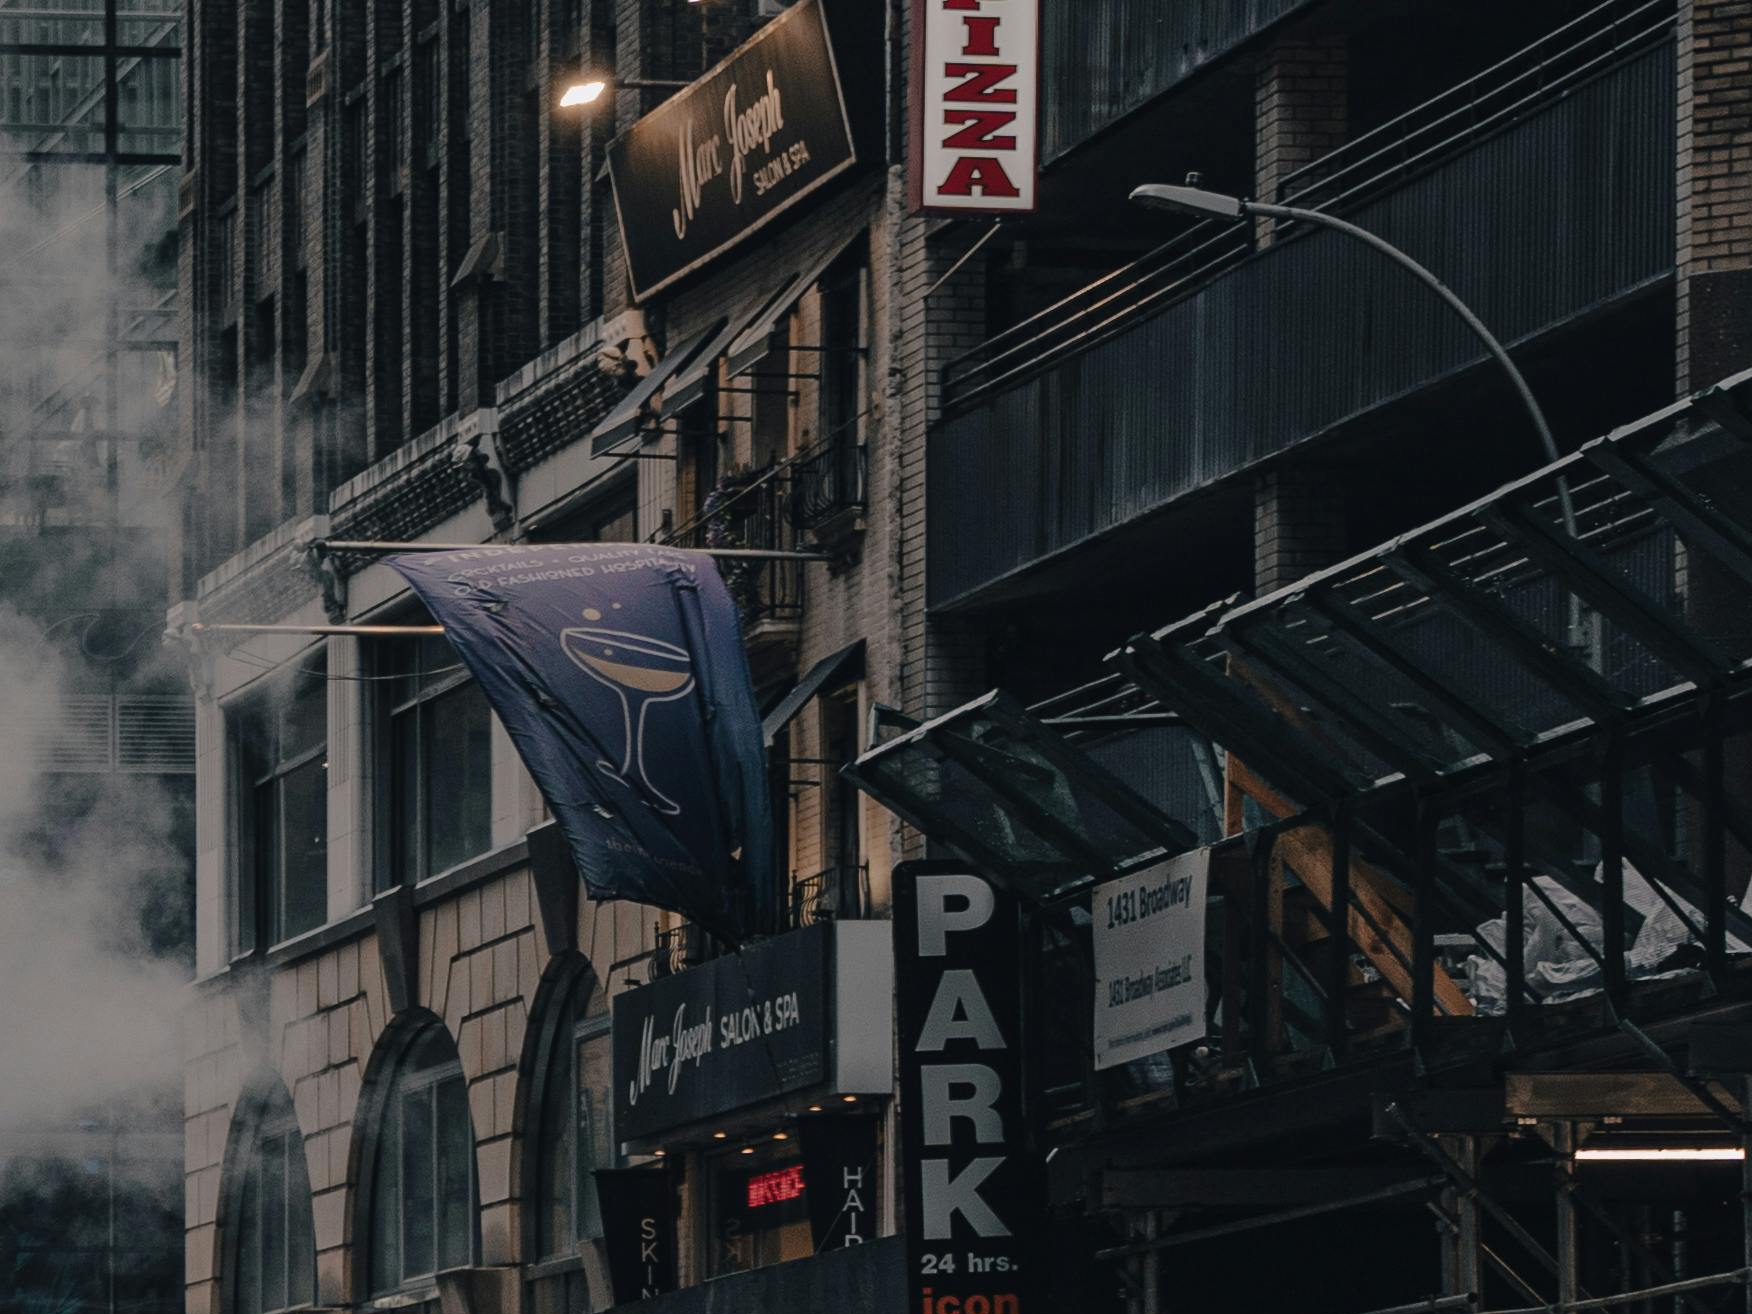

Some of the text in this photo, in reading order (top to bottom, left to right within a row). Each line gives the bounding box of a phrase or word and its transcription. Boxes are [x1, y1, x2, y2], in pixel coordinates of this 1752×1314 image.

[937, 0, 1020, 197] IZZA
[496, 567, 594, 588] FASHIONED
[1107, 873, 1193, 929] 1431 Broadway
[720, 1004, 761, 1048] SALON
[763, 1000, 773, 1035] &
[776, 992, 800, 1030] SPA
[914, 874, 1013, 1240] PARK
[920, 1252, 1019, 1275] 24 hrs.
